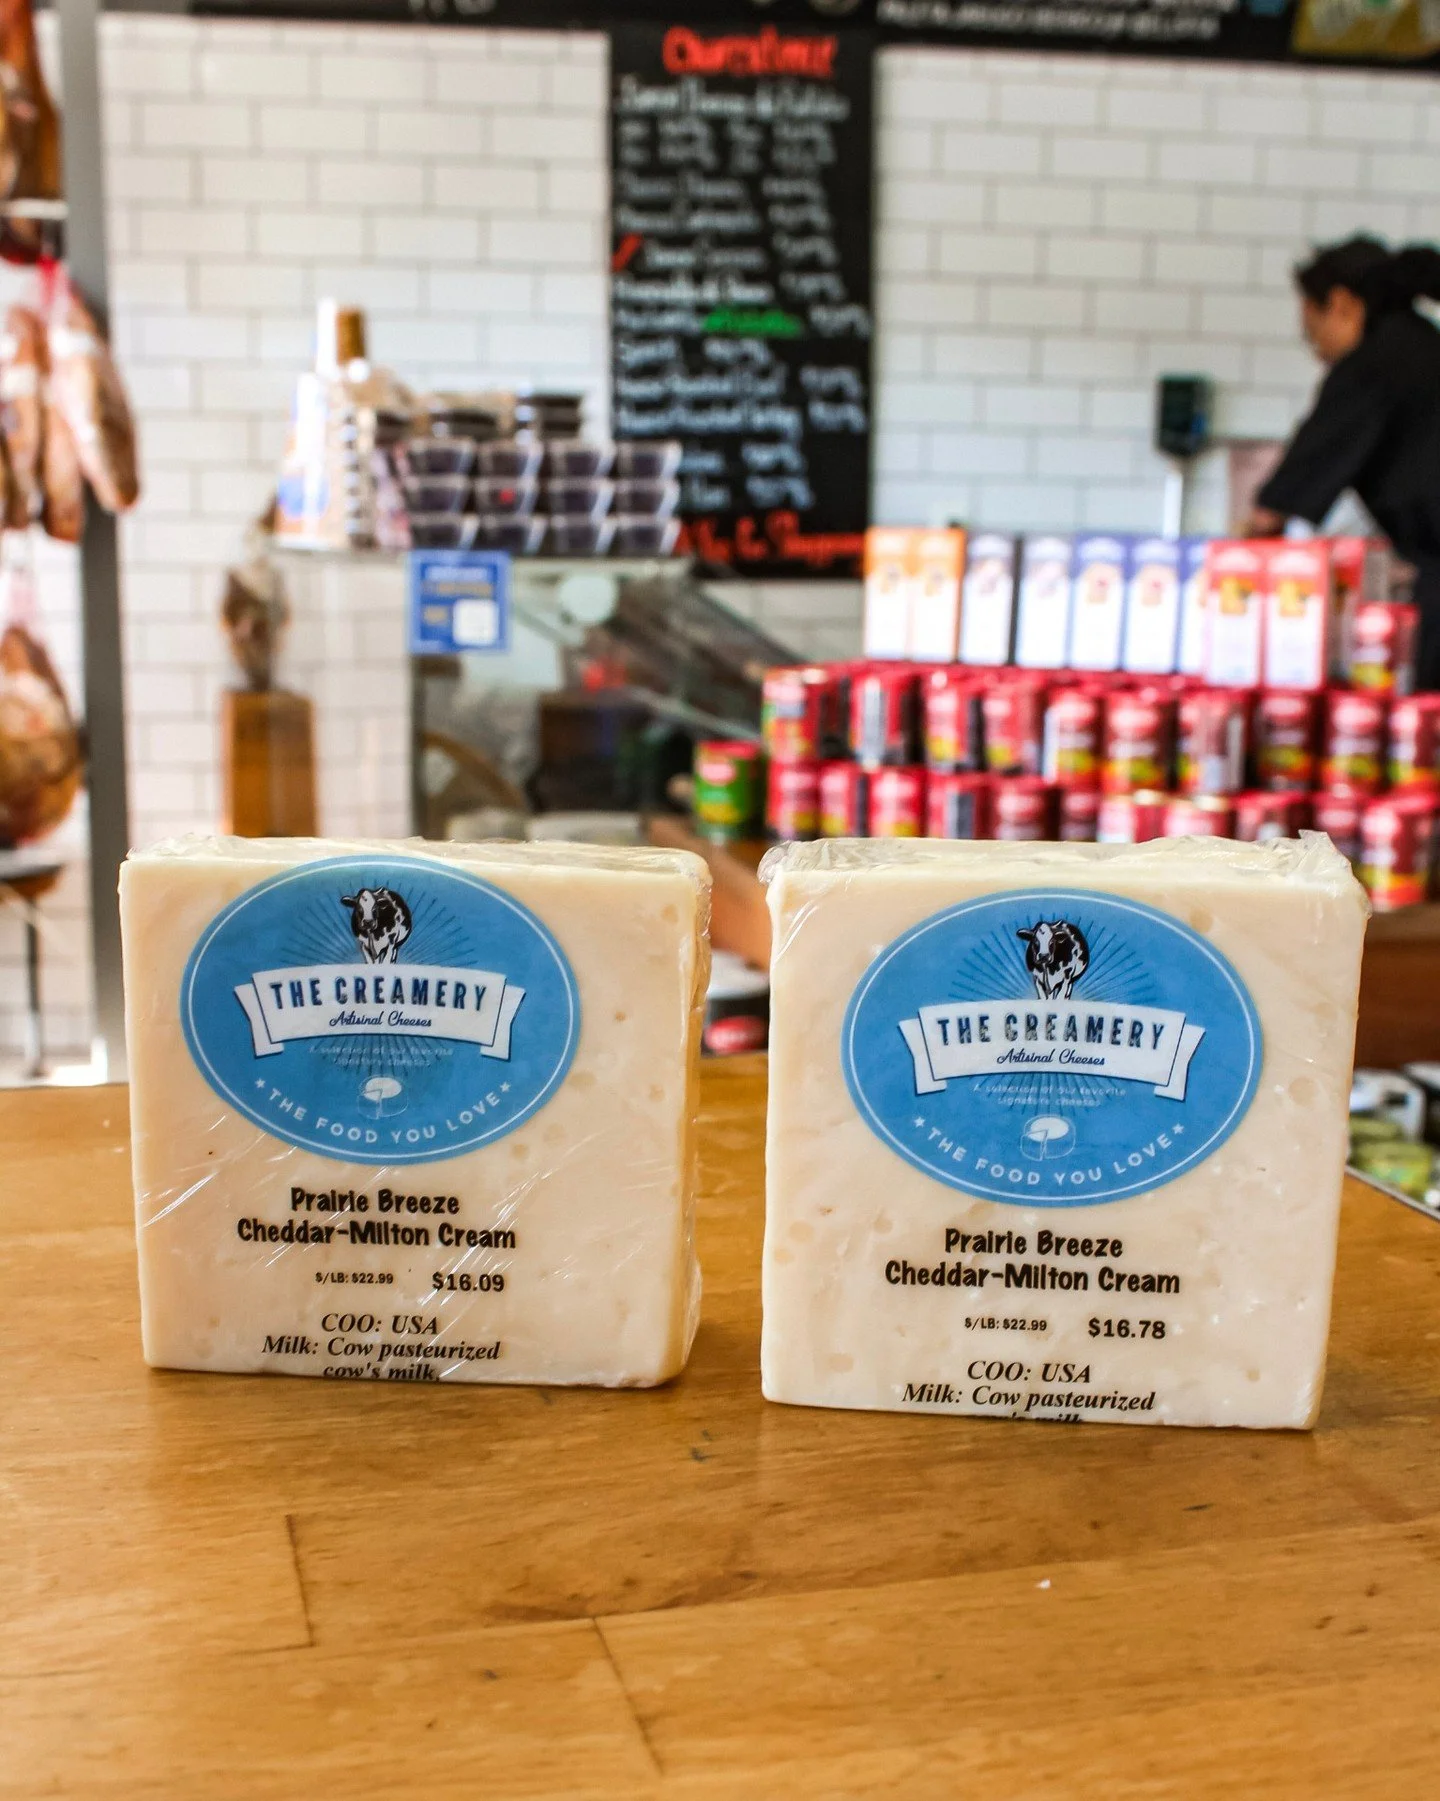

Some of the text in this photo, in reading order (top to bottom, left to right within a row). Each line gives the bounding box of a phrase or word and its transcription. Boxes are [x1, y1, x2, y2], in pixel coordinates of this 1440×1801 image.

[269, 975, 488, 1012] THE CREAMERY
[329, 1010, 433, 1027] Artisinal Cheeses
[936, 1011, 1166, 1051] THE CREAMERY
[996, 1048, 1106, 1067] Artisinal Cheeses
[269, 1087, 501, 1145] THE FOOD YOU LOVE
[928, 1127, 1173, 1187] THE FOOD YOU LOVE
[290, 1186, 460, 1215] Prairie Breeze
[237, 1217, 517, 1249] Cheddar-Milton Cream
[944, 1227, 1124, 1258] Prairie Breeze
[315, 1271, 505, 1292] $/LB: $22.99 $16.09
[884, 1259, 1181, 1294] Cheddar-Milton Cream
[321, 1312, 439, 1336] COO: USA
[964, 1316, 1167, 1340] $/LB: $22.99 $16.78
[261, 1335, 501, 1362] Milk: Cow pasteurized
[322, 1362, 380, 1380] cow's
[966, 1359, 1092, 1385] COO: USA
[901, 1382, 1156, 1413] Milk: Cow pasteurized
